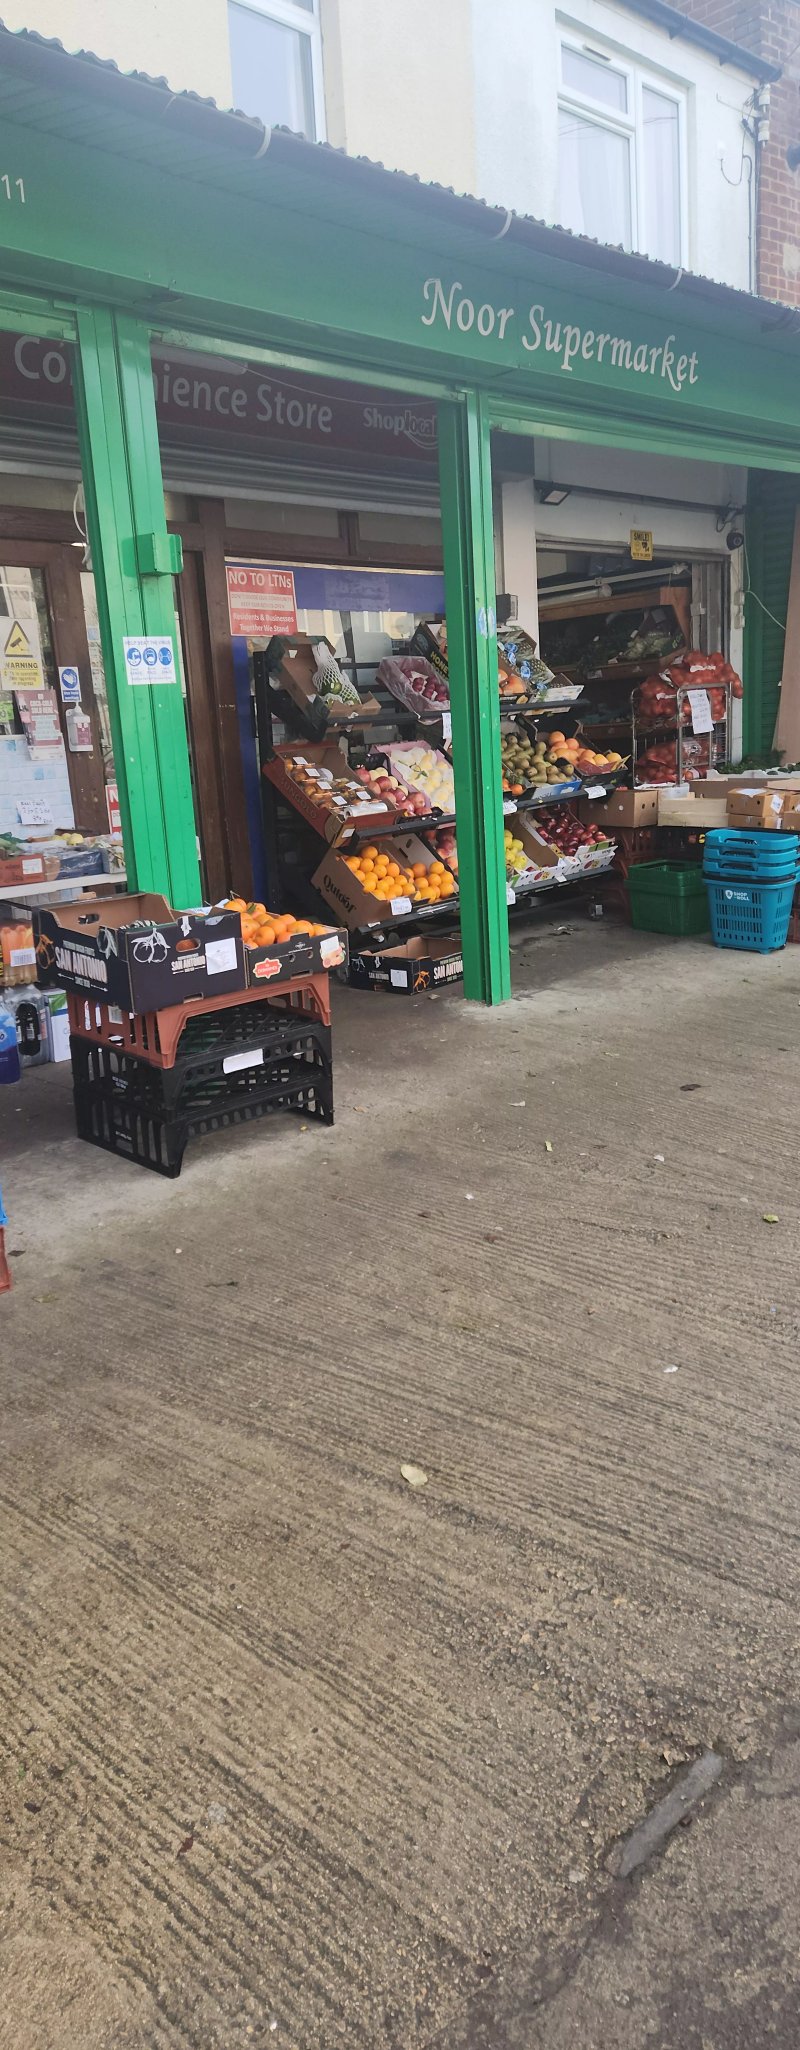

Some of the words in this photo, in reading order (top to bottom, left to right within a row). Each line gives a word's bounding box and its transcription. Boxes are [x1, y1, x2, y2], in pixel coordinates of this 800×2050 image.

[421, 279, 514, 340] Noor
[522, 305, 699, 391] Supermarket
[256, 384, 332, 432] Store
[229, 571, 248, 585] NO
[249, 572, 265, 586] TO
[269, 574, 292, 588] LTNs
[266, 614, 294, 622] Businesses
[55, 946, 73, 972] SAN
[72, 951, 108, 984] ANTONIO
[171, 960, 183, 971] SAN
[183, 955, 206, 968] ANTONIO
[434, 965, 446, 980] SAN
